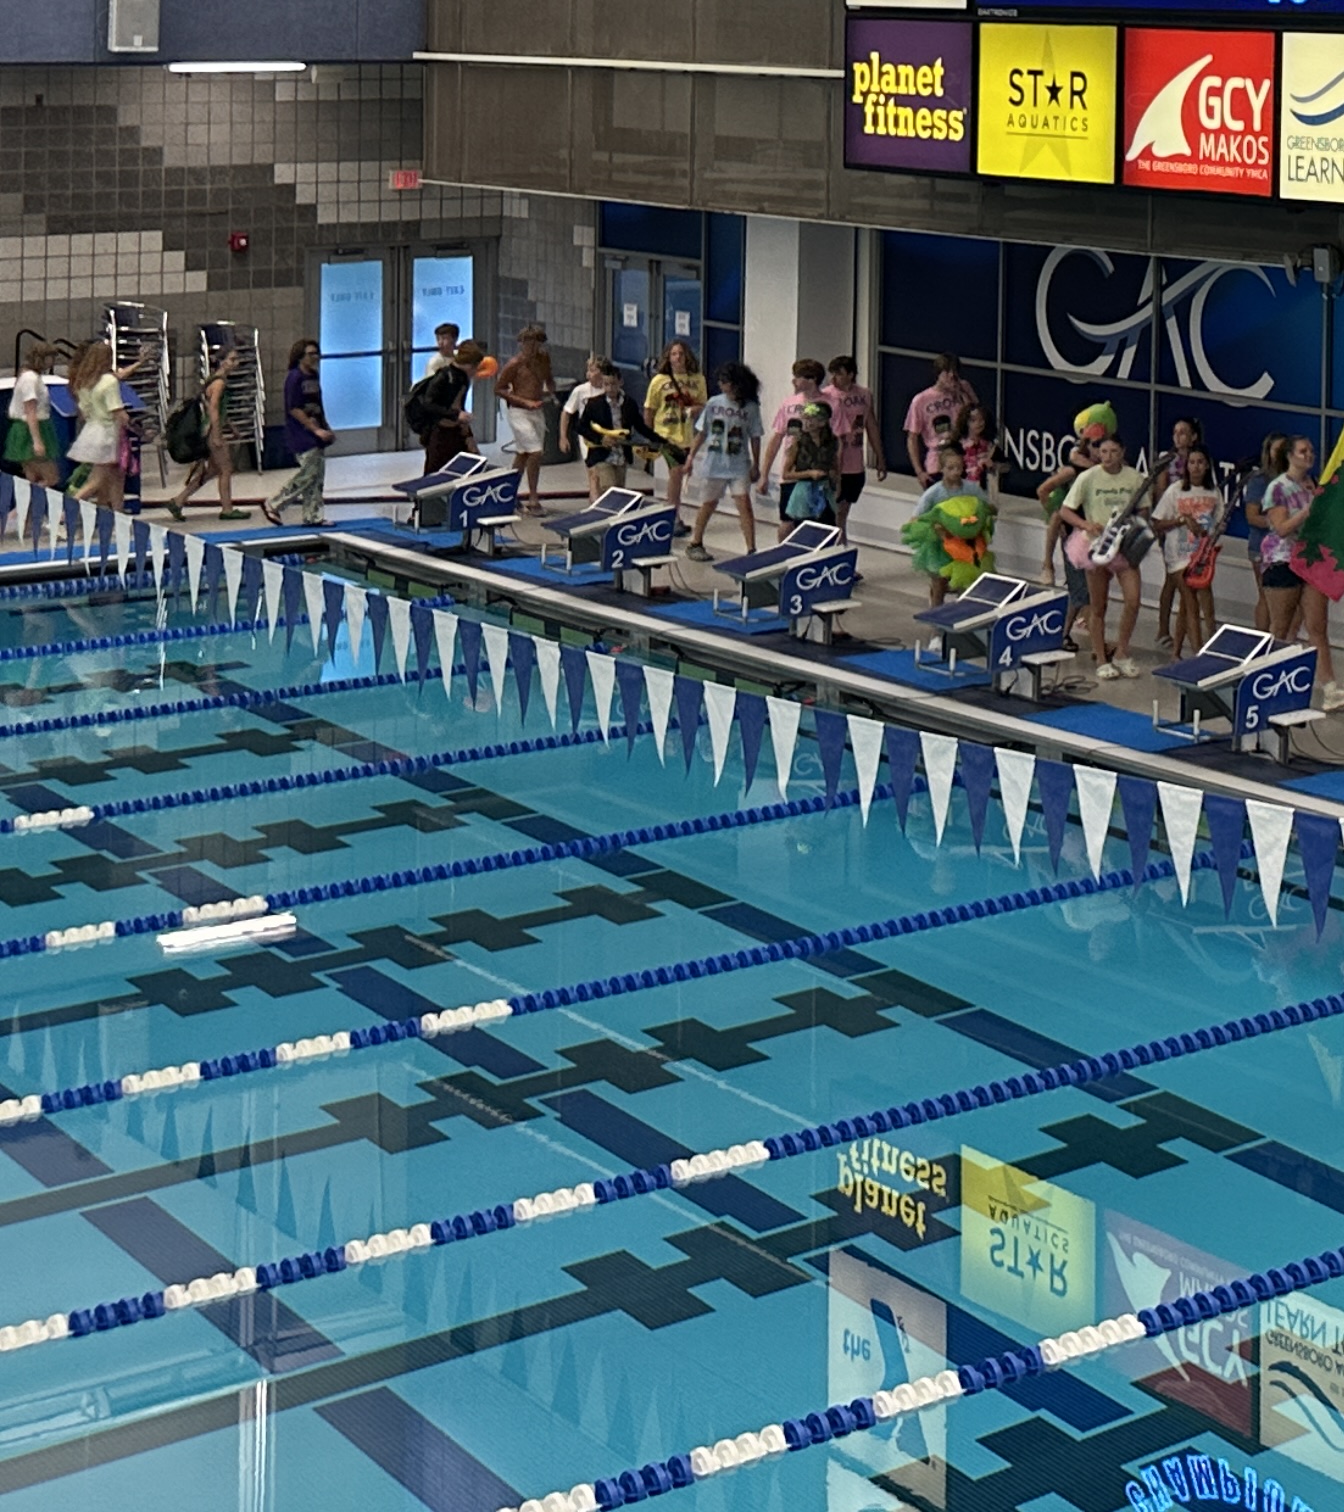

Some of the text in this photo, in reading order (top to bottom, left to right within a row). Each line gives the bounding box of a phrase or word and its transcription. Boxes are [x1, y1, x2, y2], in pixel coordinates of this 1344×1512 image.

[852, 51, 944, 103] planet
[863, 93, 965, 141] fitness
[1199, 76, 1270, 132] GCY
[1007, 113, 1088, 132] AQUATICS
[1199, 133, 1269, 165] MAKOS
[1246, 168, 1269, 180] YMCA
[1035, 245, 1276, 407] GAC
[462, 482, 514, 507] GAC
[459, 510, 468, 528] 1
[617, 519, 672, 546] GAC
[611, 549, 624, 569] 2
[796, 562, 852, 591] GAC
[790, 595, 802, 615] 3
[1006, 610, 1063, 640] GAC
[998, 646, 1013, 667] 4
[1252, 666, 1311, 700] GAC
[1245, 705, 1259, 729] 5
